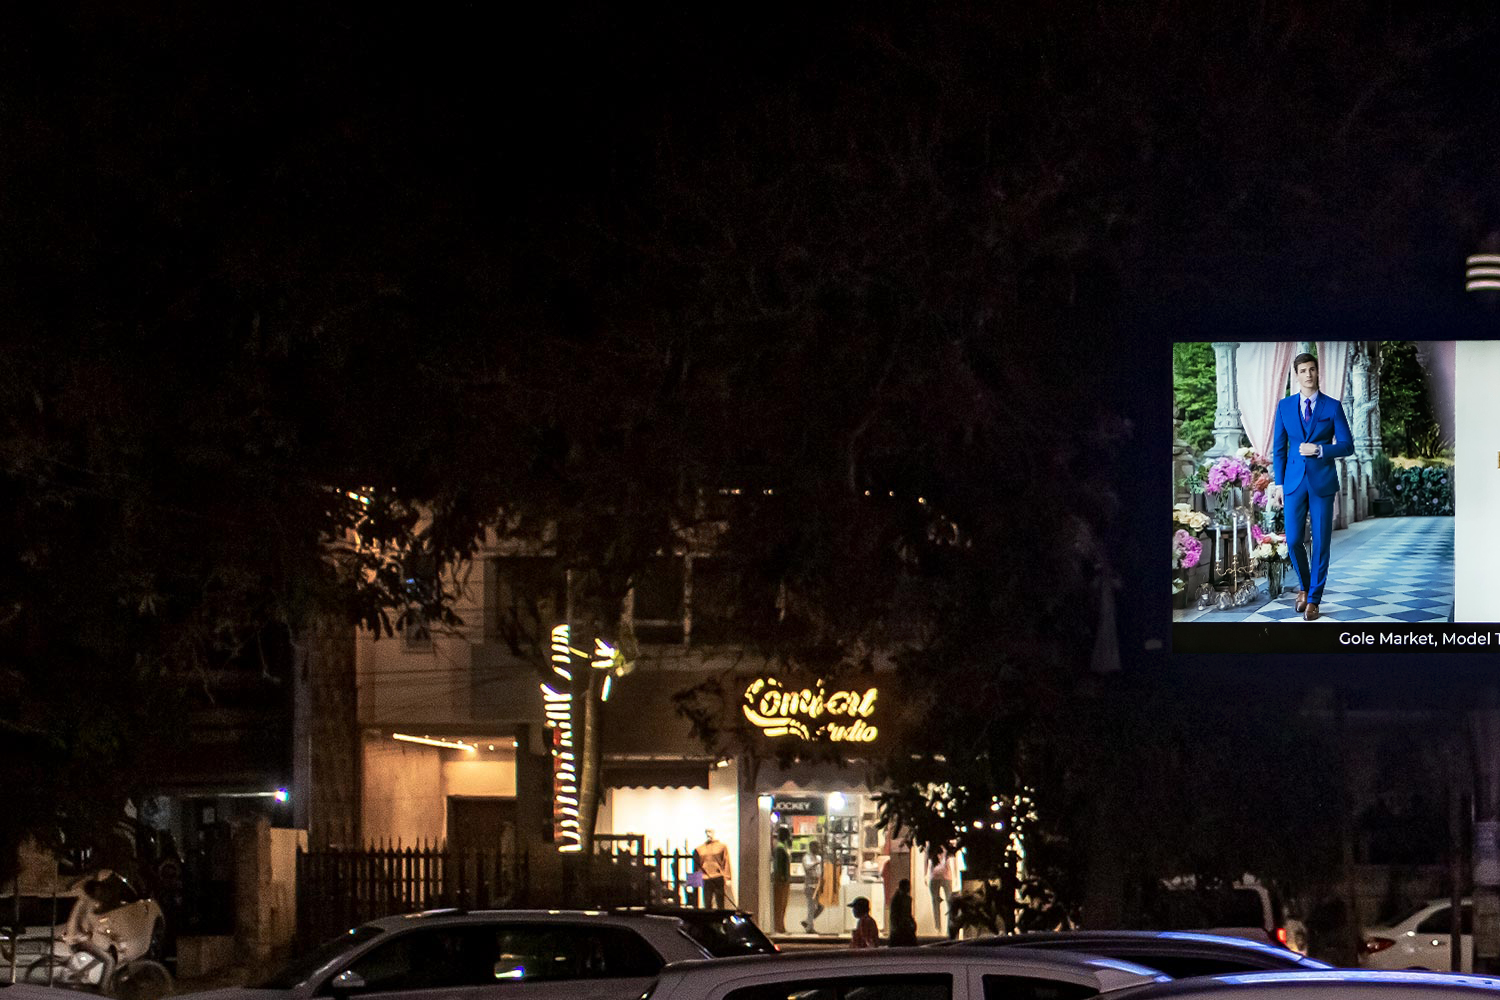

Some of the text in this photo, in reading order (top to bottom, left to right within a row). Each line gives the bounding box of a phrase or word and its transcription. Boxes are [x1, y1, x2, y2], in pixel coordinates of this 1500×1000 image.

[1338, 631, 1375, 645] Gole
[1379, 631, 1438, 647] Market,
[1442, 631, 1490, 645] Model
